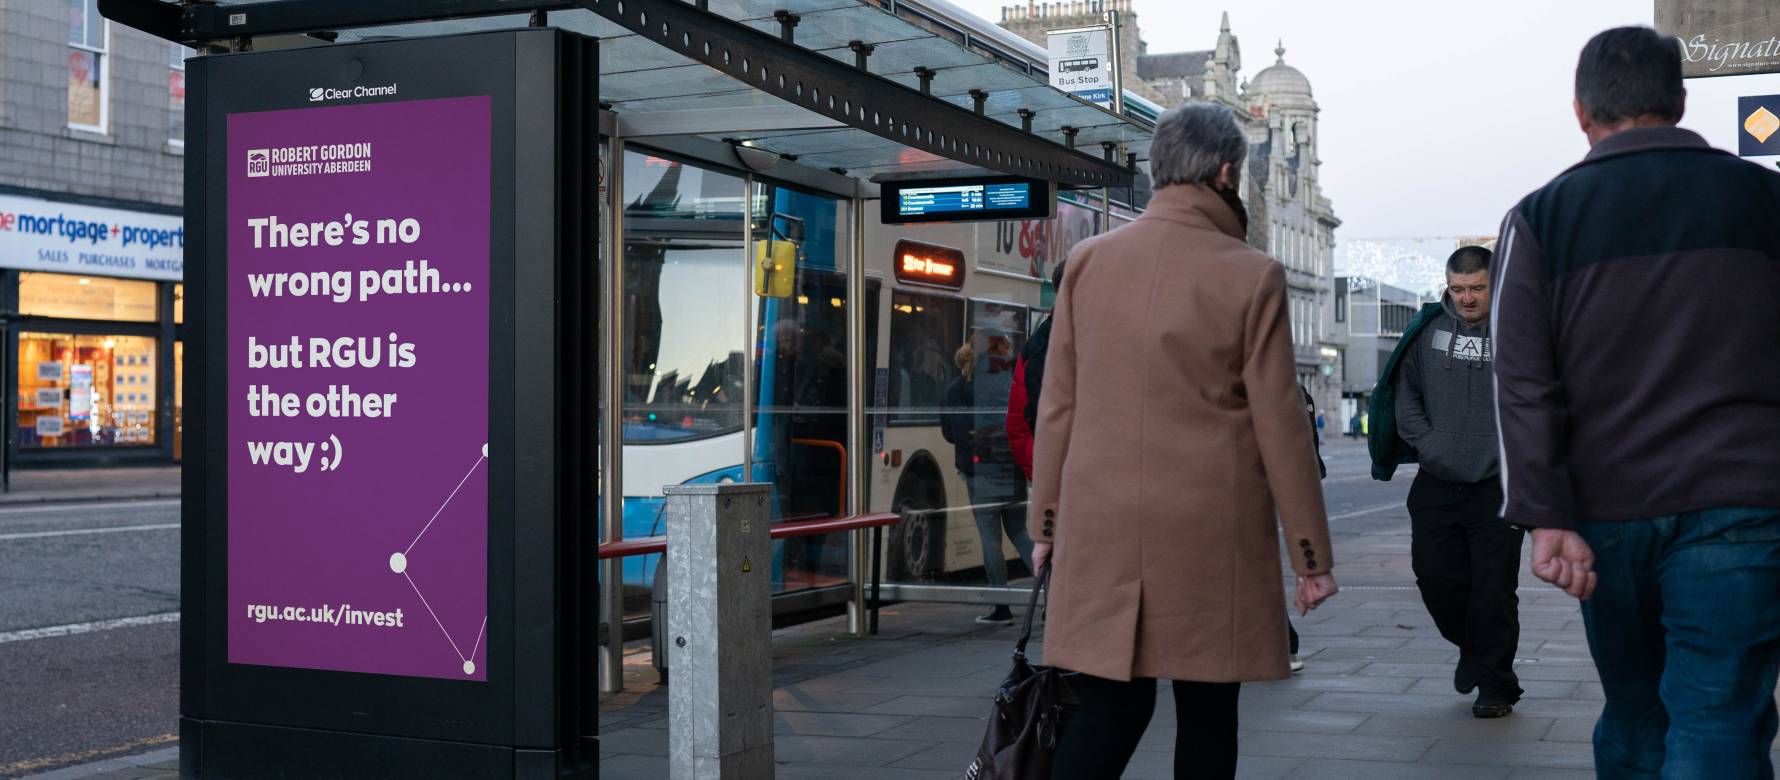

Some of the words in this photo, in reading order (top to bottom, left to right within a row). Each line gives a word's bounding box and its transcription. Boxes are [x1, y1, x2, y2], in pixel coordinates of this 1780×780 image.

[1676, 33, 1780, 71] Signat
[325, 88, 352, 100] Clear
[353, 83, 397, 98] Channel
[1078, 76, 1099, 84] Stop
[249, 160, 268, 174] RGU
[271, 146, 318, 163] ROBERT
[320, 142, 371, 161] GORDON
[271, 162, 324, 177] UNIVERSITY
[324, 159, 371, 175] ABERDEEN
[18, 213, 108, 244] mortgage
[122, 225, 184, 249] propert
[247, 212, 370, 248] There’s
[376, 217, 421, 244] no
[38, 249, 69, 263] SALES
[78, 252, 136, 269] PURCHASES
[145, 258, 184, 273] MORTGA
[247, 270, 352, 303] wrong
[359, 259, 472, 302] path...
[248, 335, 303, 368] but
[309, 336, 381, 368] RGU
[388, 332, 417, 368] is
[247, 384, 301, 417] the
[305, 384, 398, 418] other
[247, 441, 316, 473] way
[320, 433, 343, 472] ;)
[247, 603, 404, 628] rgu.ac.uk/invest
